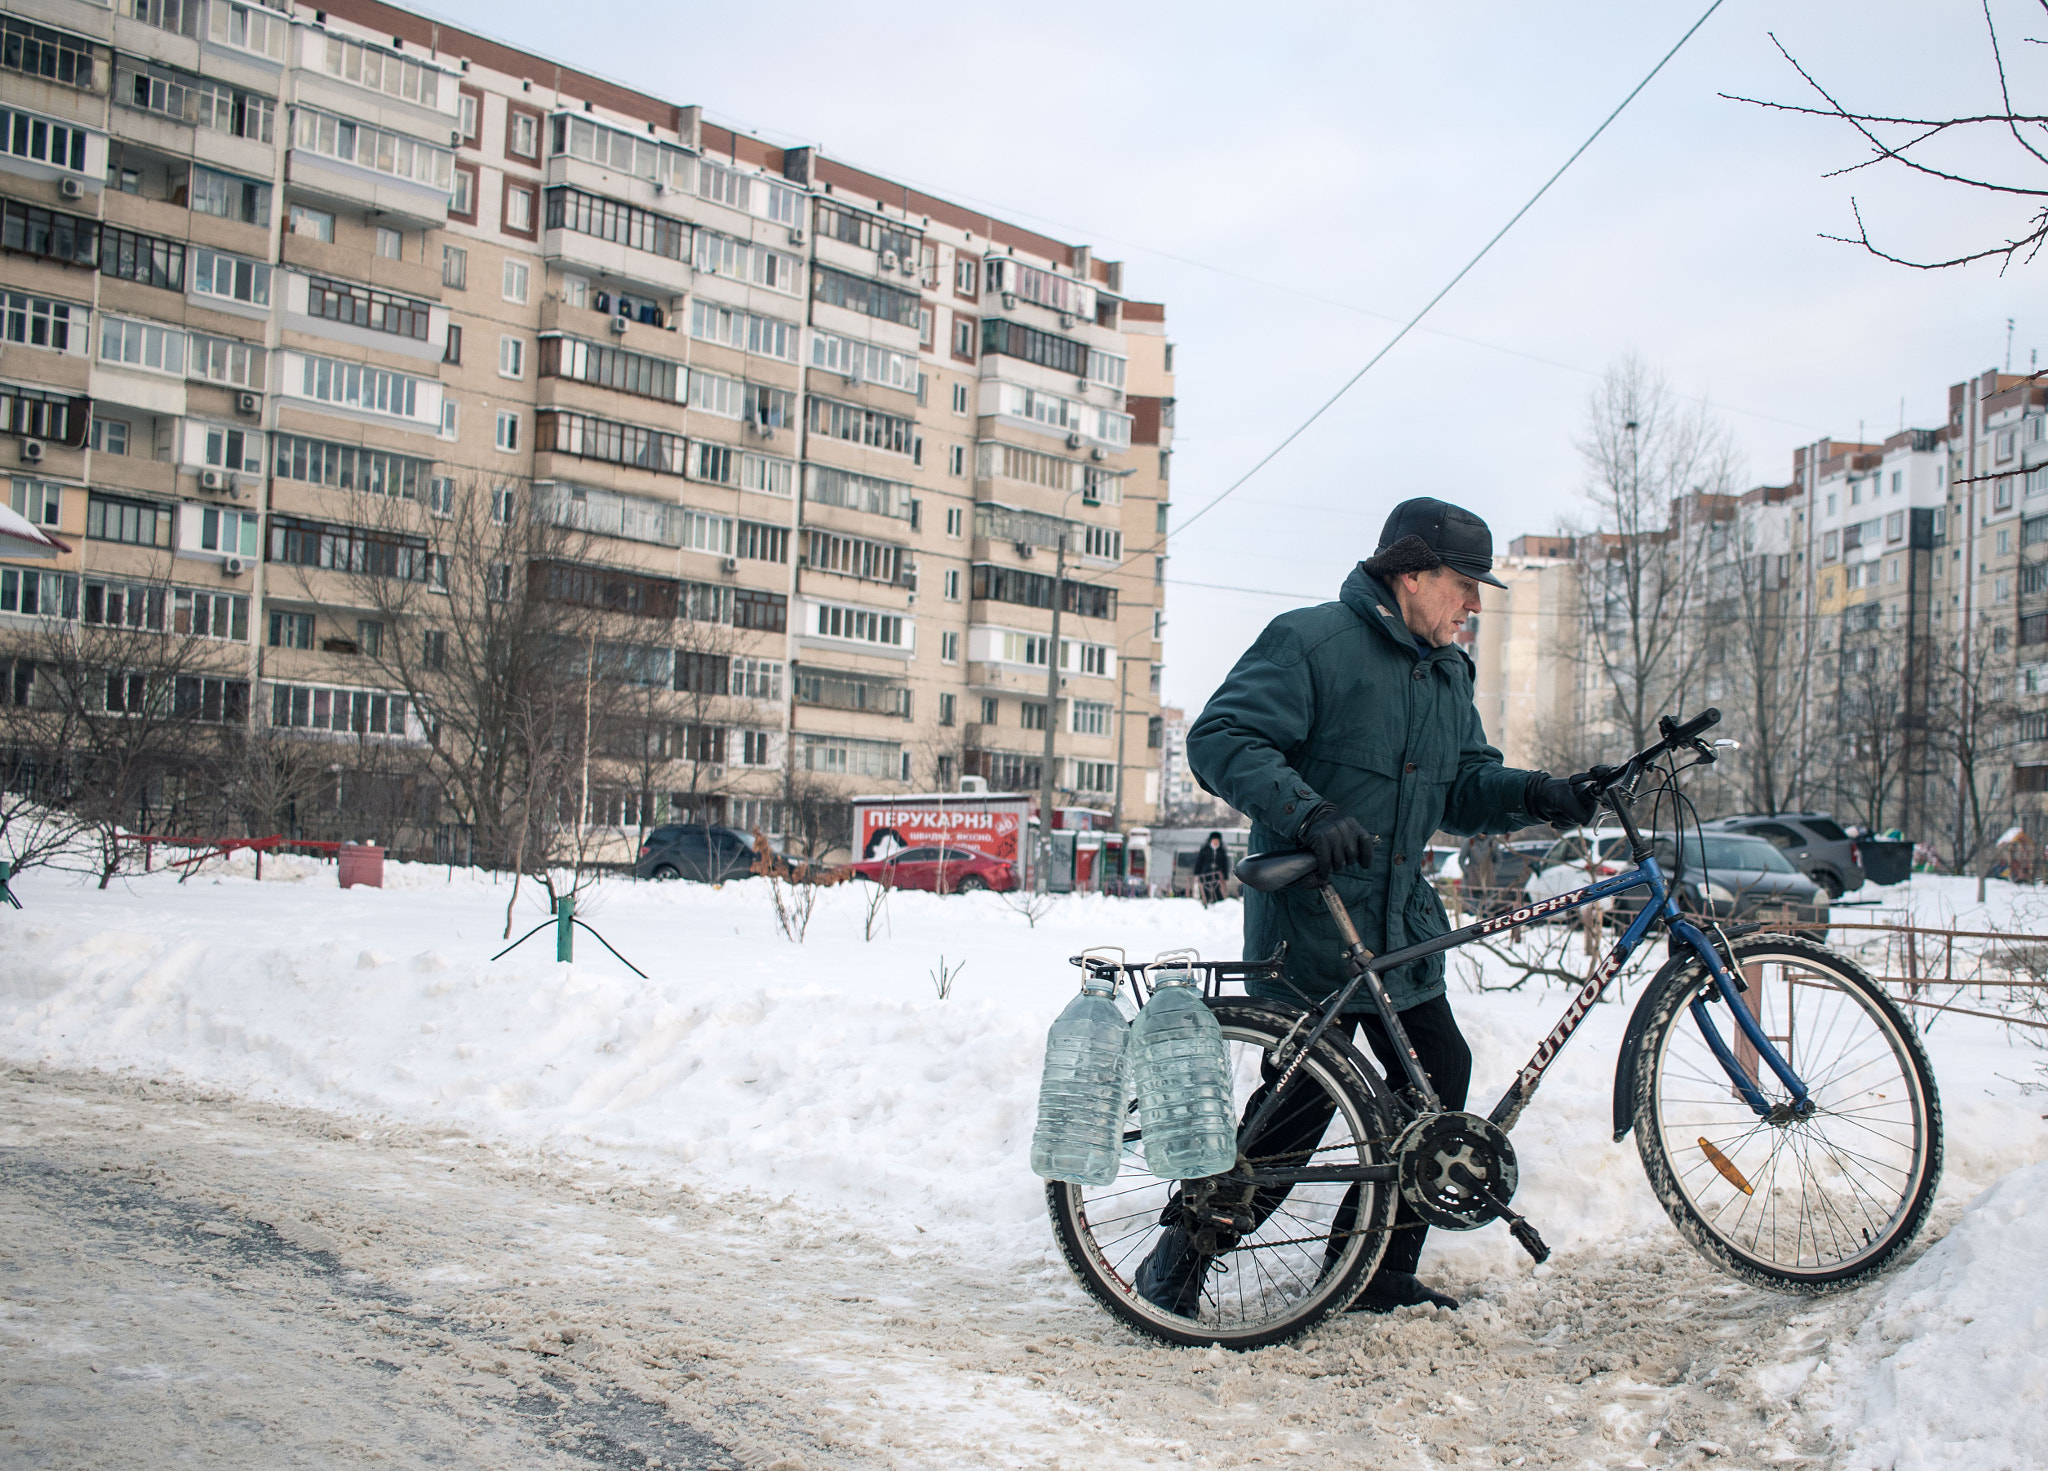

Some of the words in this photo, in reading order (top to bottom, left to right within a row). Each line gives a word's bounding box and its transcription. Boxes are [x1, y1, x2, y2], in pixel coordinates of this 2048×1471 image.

[869, 811, 993, 829] ПЕРУКАРНЯ
[1481, 890, 1584, 933] TROPHY
[1521, 954, 1621, 1087] AUTHOR
[1276, 1044, 1309, 1092] AUTHOR
